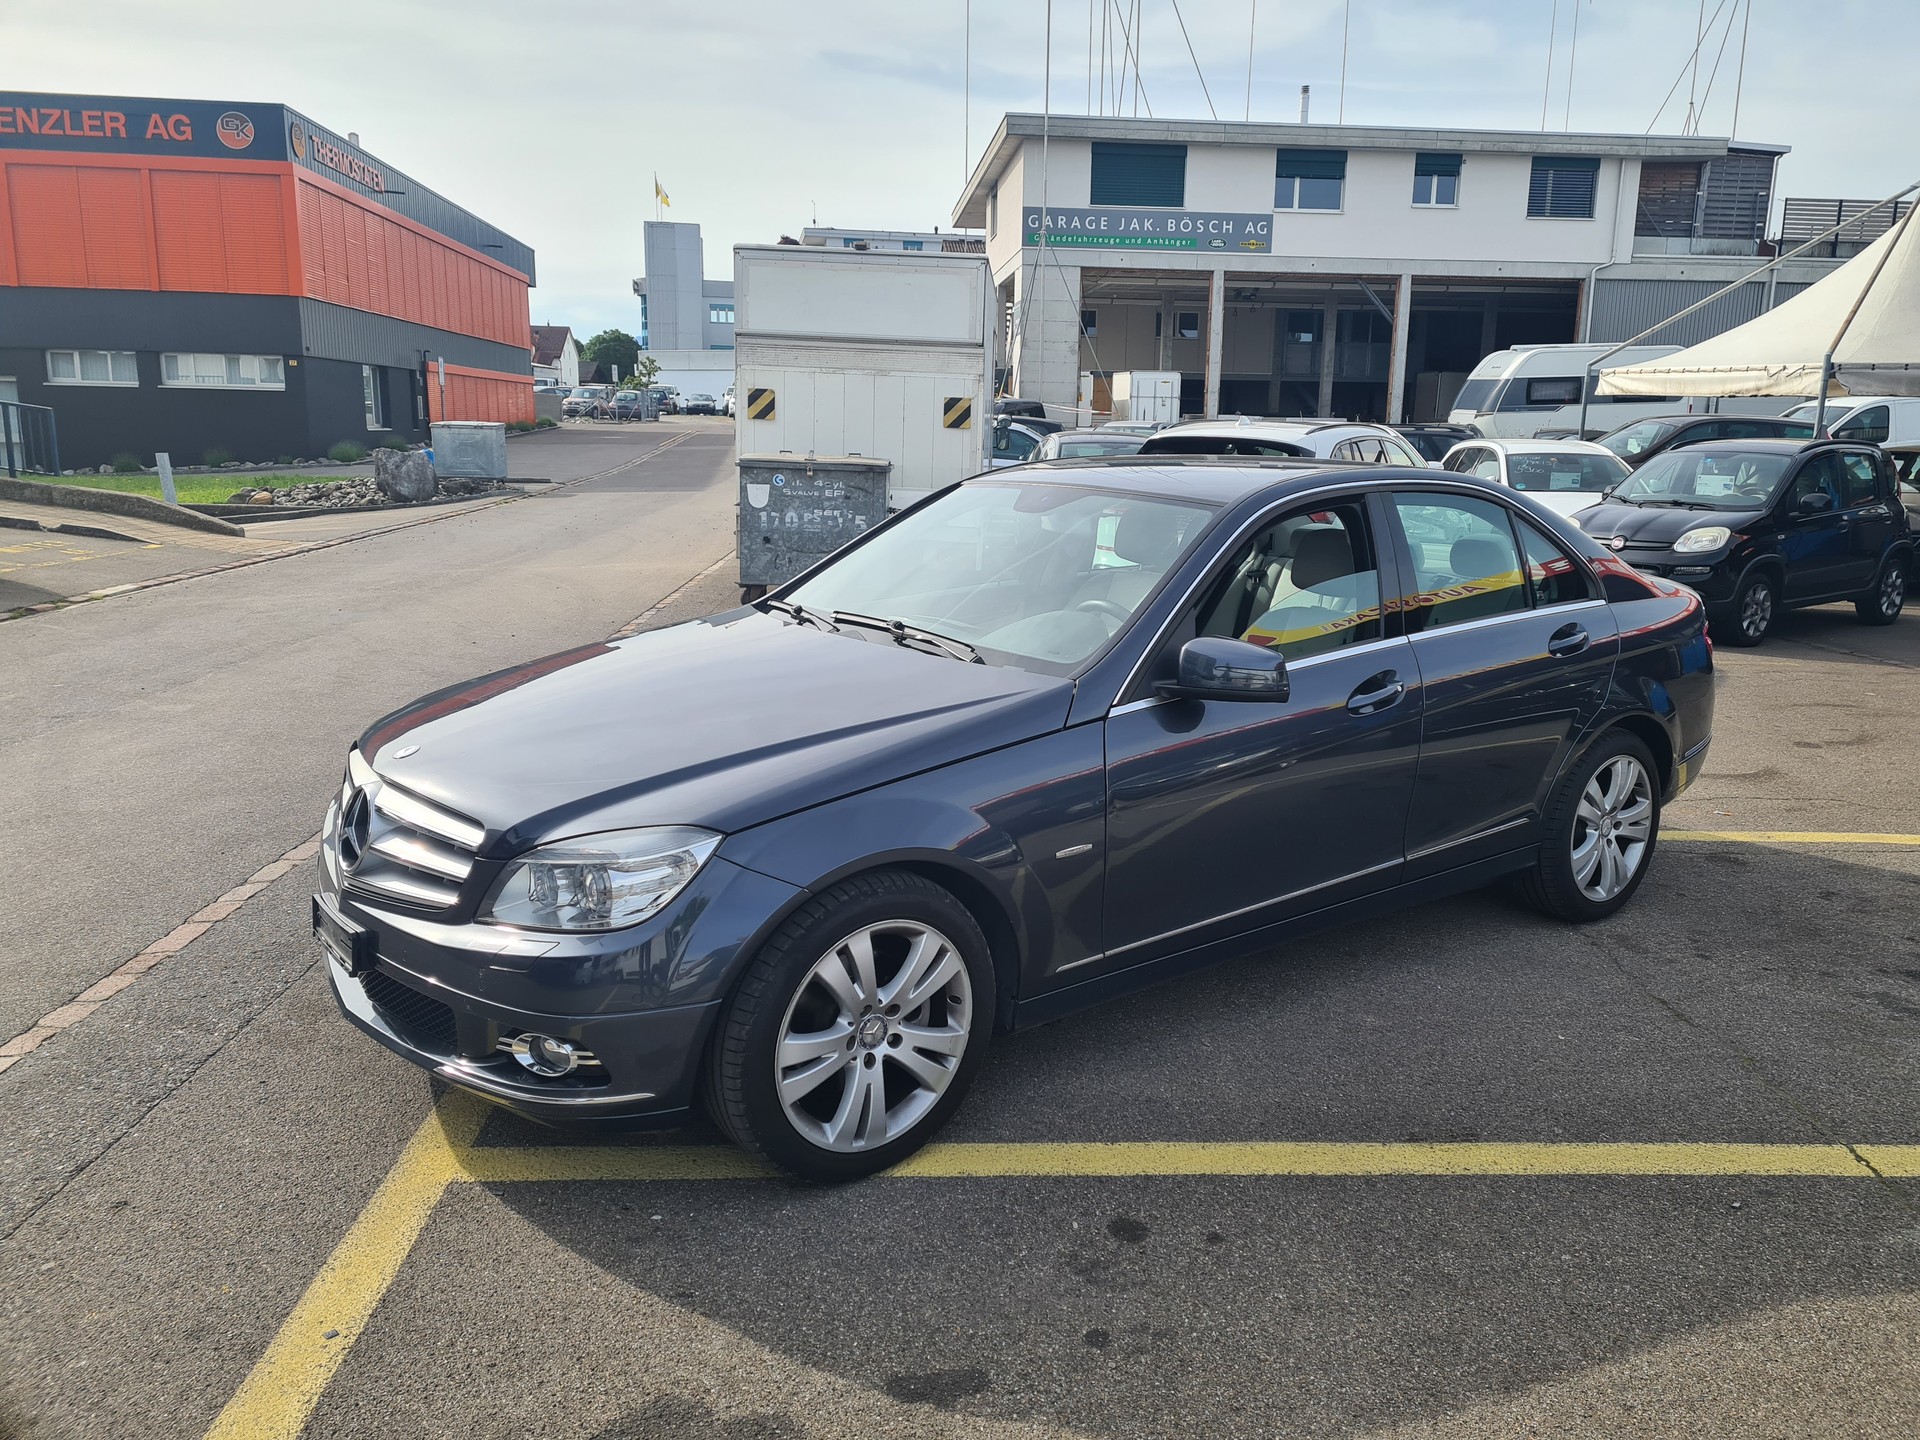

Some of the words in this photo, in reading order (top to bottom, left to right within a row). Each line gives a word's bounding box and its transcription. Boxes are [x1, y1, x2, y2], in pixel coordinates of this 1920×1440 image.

[145, 113, 193, 141] AG
[311, 134, 385, 193] THERMOSTATEN
[1028, 214, 1108, 230] GARAGE
[1119, 217, 1160, 231] JAK.
[1167, 216, 1233, 233] BÖSCH
[1245, 221, 1267, 235] AG
[1034, 234, 1120, 245] Gländefahrzeuge
[1147, 238, 1191, 247] Anhänger
